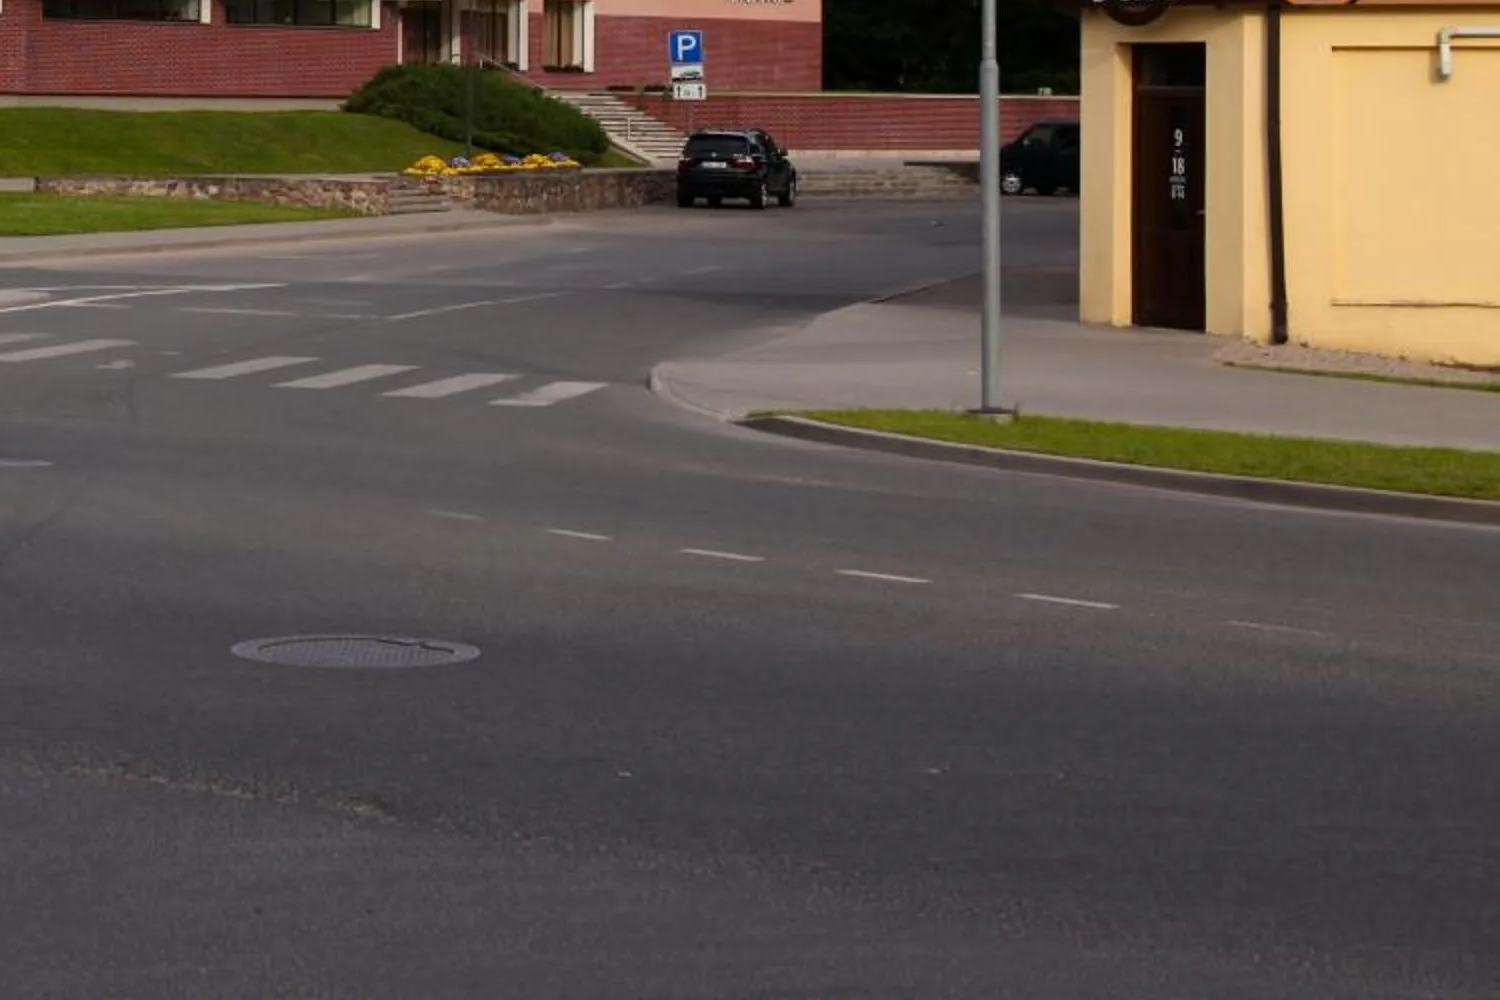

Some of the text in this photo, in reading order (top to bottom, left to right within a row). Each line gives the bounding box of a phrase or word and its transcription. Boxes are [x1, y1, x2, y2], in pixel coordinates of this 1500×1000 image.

[677, 34, 697, 61] P
[1173, 128, 1183, 147] 9
[1172, 157, 1185, 175] 18
